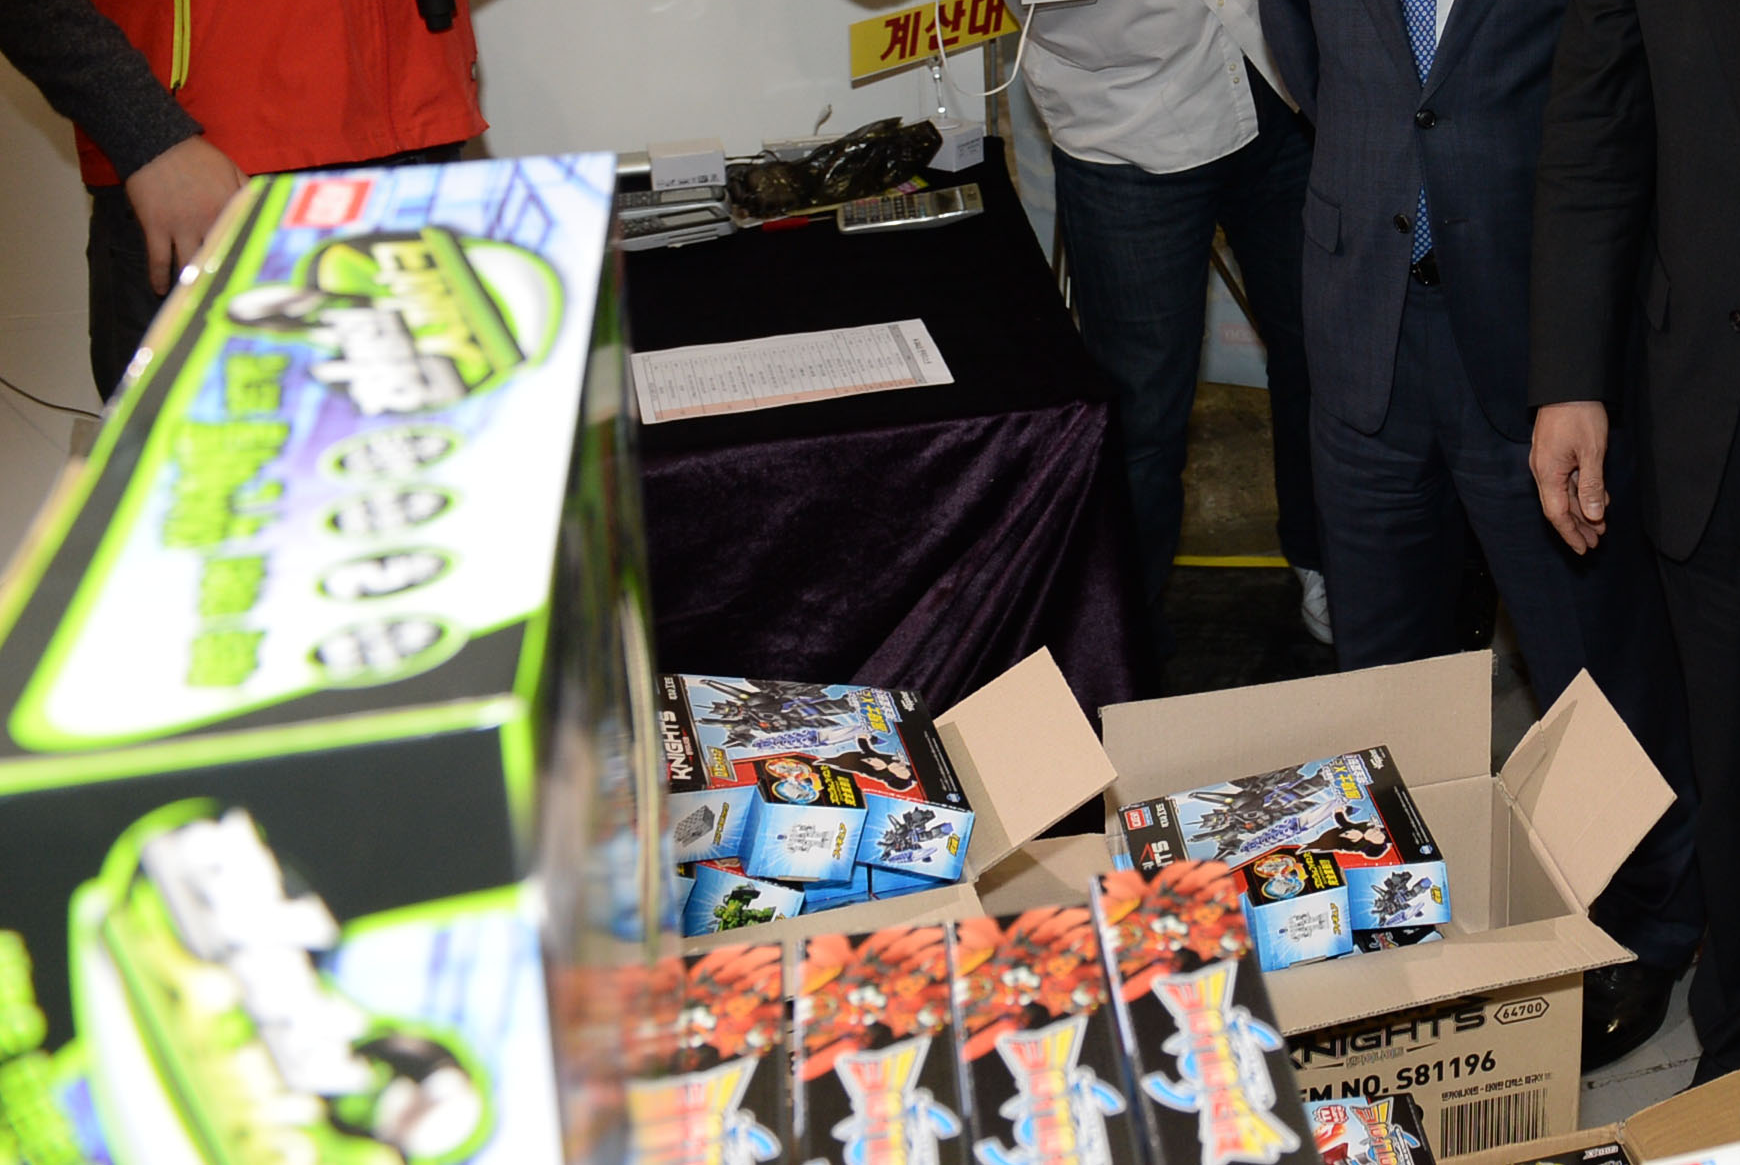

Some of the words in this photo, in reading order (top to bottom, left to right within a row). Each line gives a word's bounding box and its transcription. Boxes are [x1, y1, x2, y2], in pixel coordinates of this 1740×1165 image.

[661, 710, 694, 780] KNIGHTS
[1502, 1002, 1542, 1020] 64700
[1341, 1074, 1389, 1098] NO.
[1396, 1049, 1496, 1090] S81196
